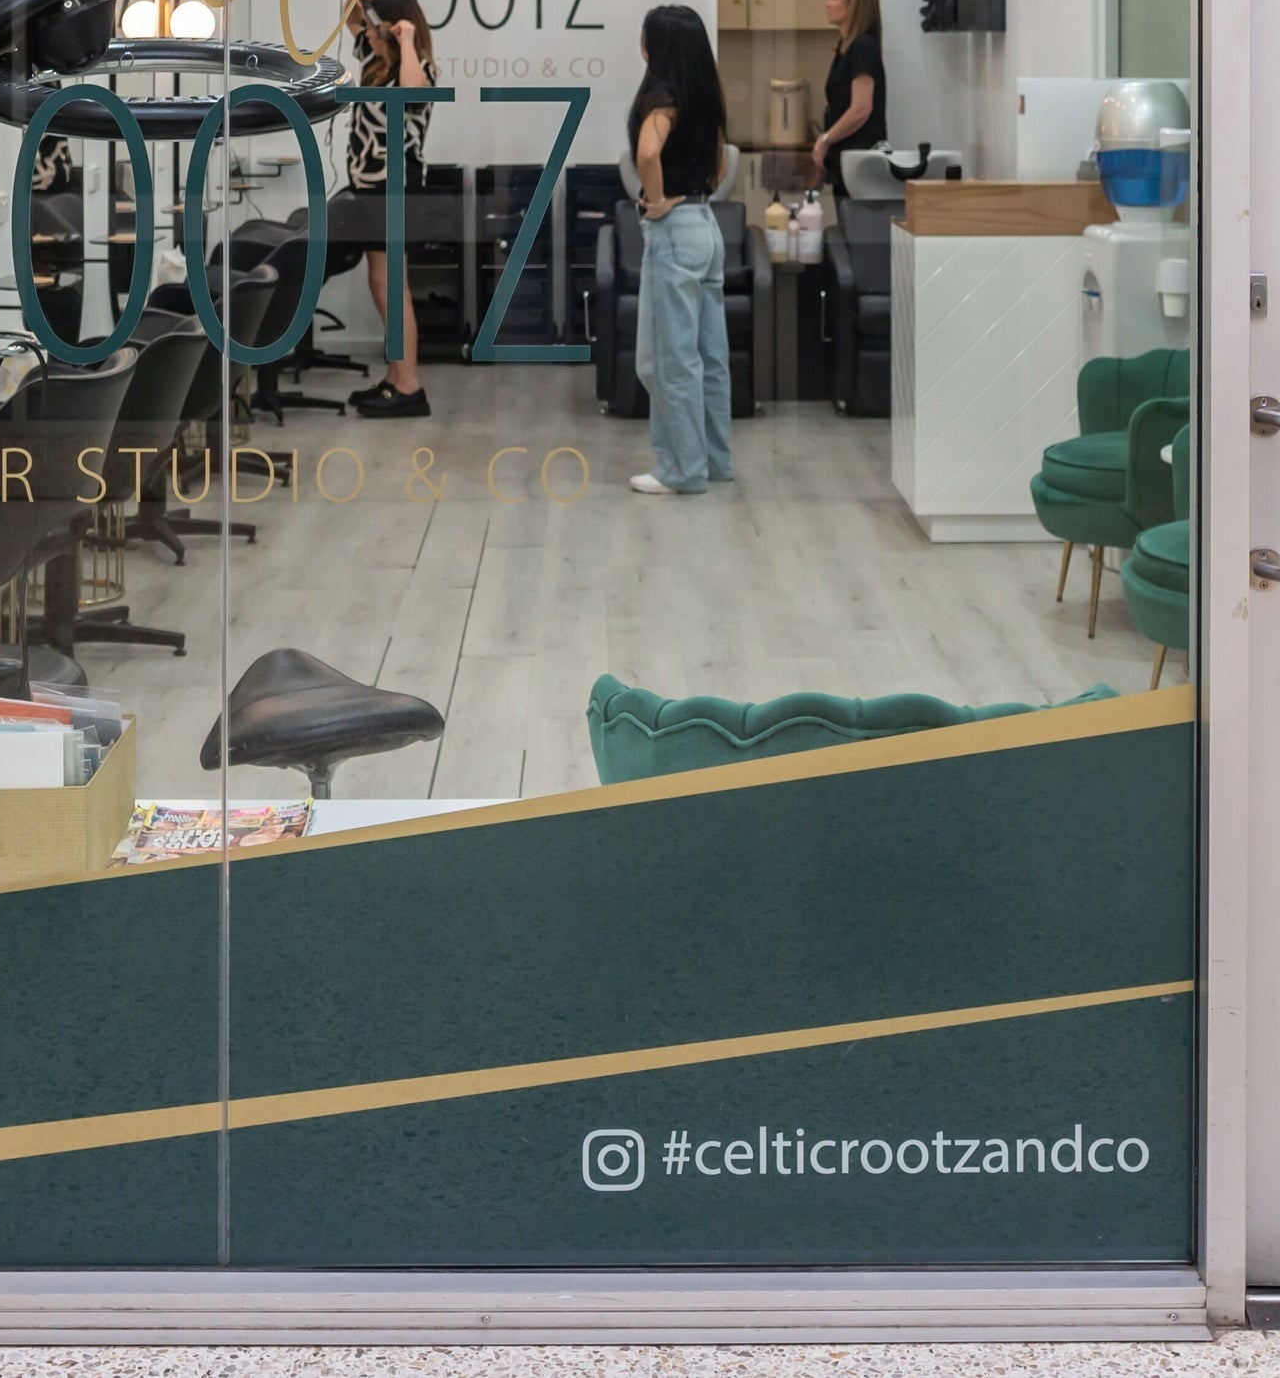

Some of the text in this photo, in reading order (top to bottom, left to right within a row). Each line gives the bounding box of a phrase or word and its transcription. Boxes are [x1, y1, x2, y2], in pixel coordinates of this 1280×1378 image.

[435, 57, 605, 79] TUDIO & CO
[75, 446, 367, 505] STUDIO
[405, 446, 448, 504] &
[486, 446, 591, 504] CO
[662, 1124, 1150, 1176] #celticrootzandco
